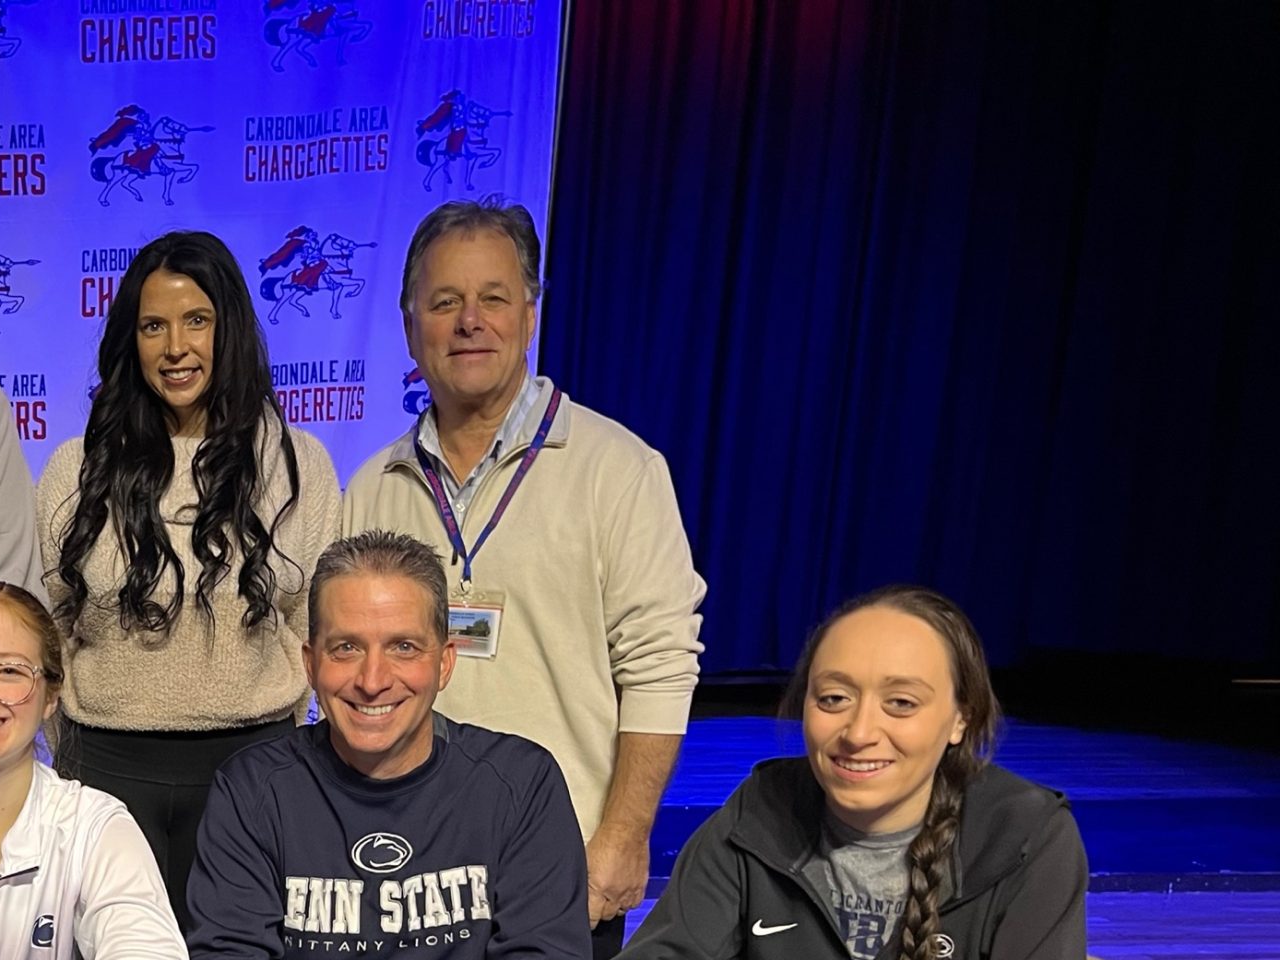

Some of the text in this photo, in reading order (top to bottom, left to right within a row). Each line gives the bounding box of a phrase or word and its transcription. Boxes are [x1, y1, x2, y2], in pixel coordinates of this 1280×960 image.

[81, 16, 217, 63] CHARGERS
[9, 124, 46, 149] AREA
[245, 105, 389, 142] CARBONDALE AREA
[244, 133, 389, 182] CHARGERETTES
[12, 373, 46, 397] AREA
[344, 360, 365, 383] AREA
[284, 863, 492, 934] ENN STATE
[284, 928, 471, 952] NITTANY LIONS
